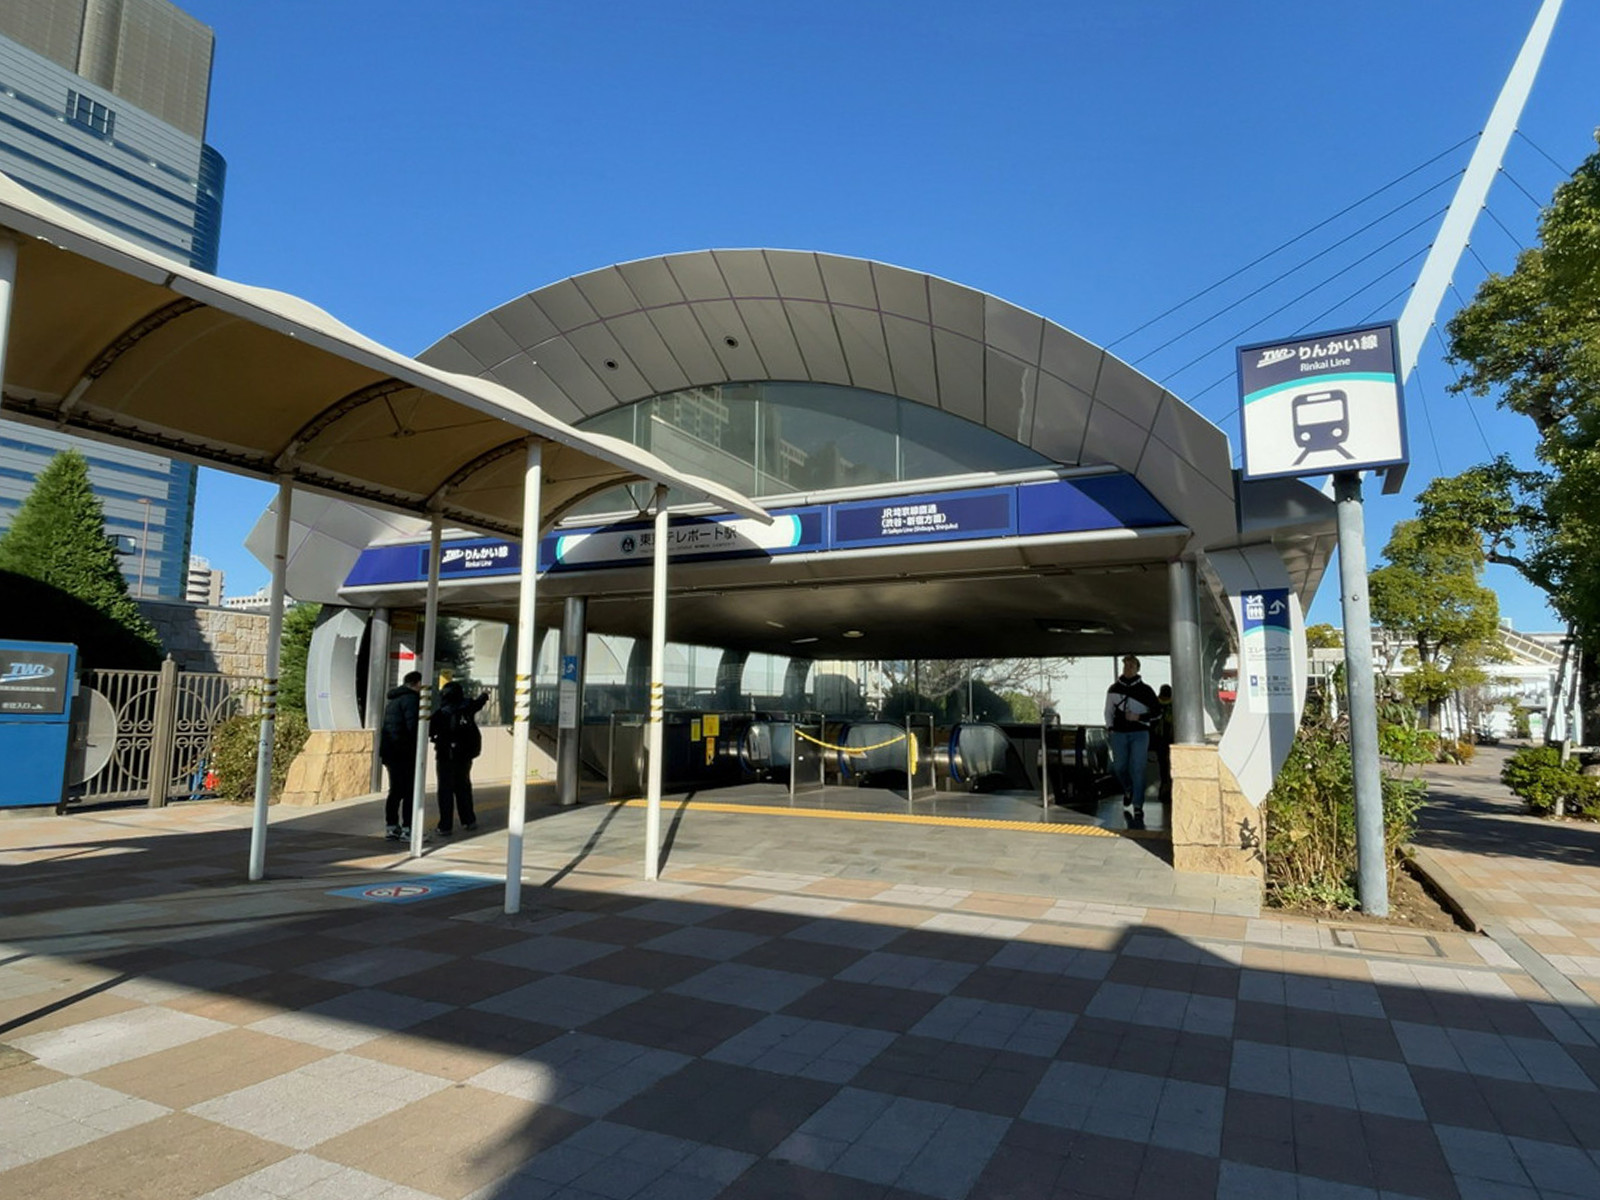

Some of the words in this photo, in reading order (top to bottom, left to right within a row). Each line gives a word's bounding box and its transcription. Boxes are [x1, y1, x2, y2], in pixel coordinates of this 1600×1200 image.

[1299, 334, 1378, 360] りんかい線
[1300, 361, 1329, 372] Rinkai
[1330, 357, 1351, 367] Line
[640, 525, 737, 546] 東テレポート駅
[465, 545, 509, 561] りんかい線
